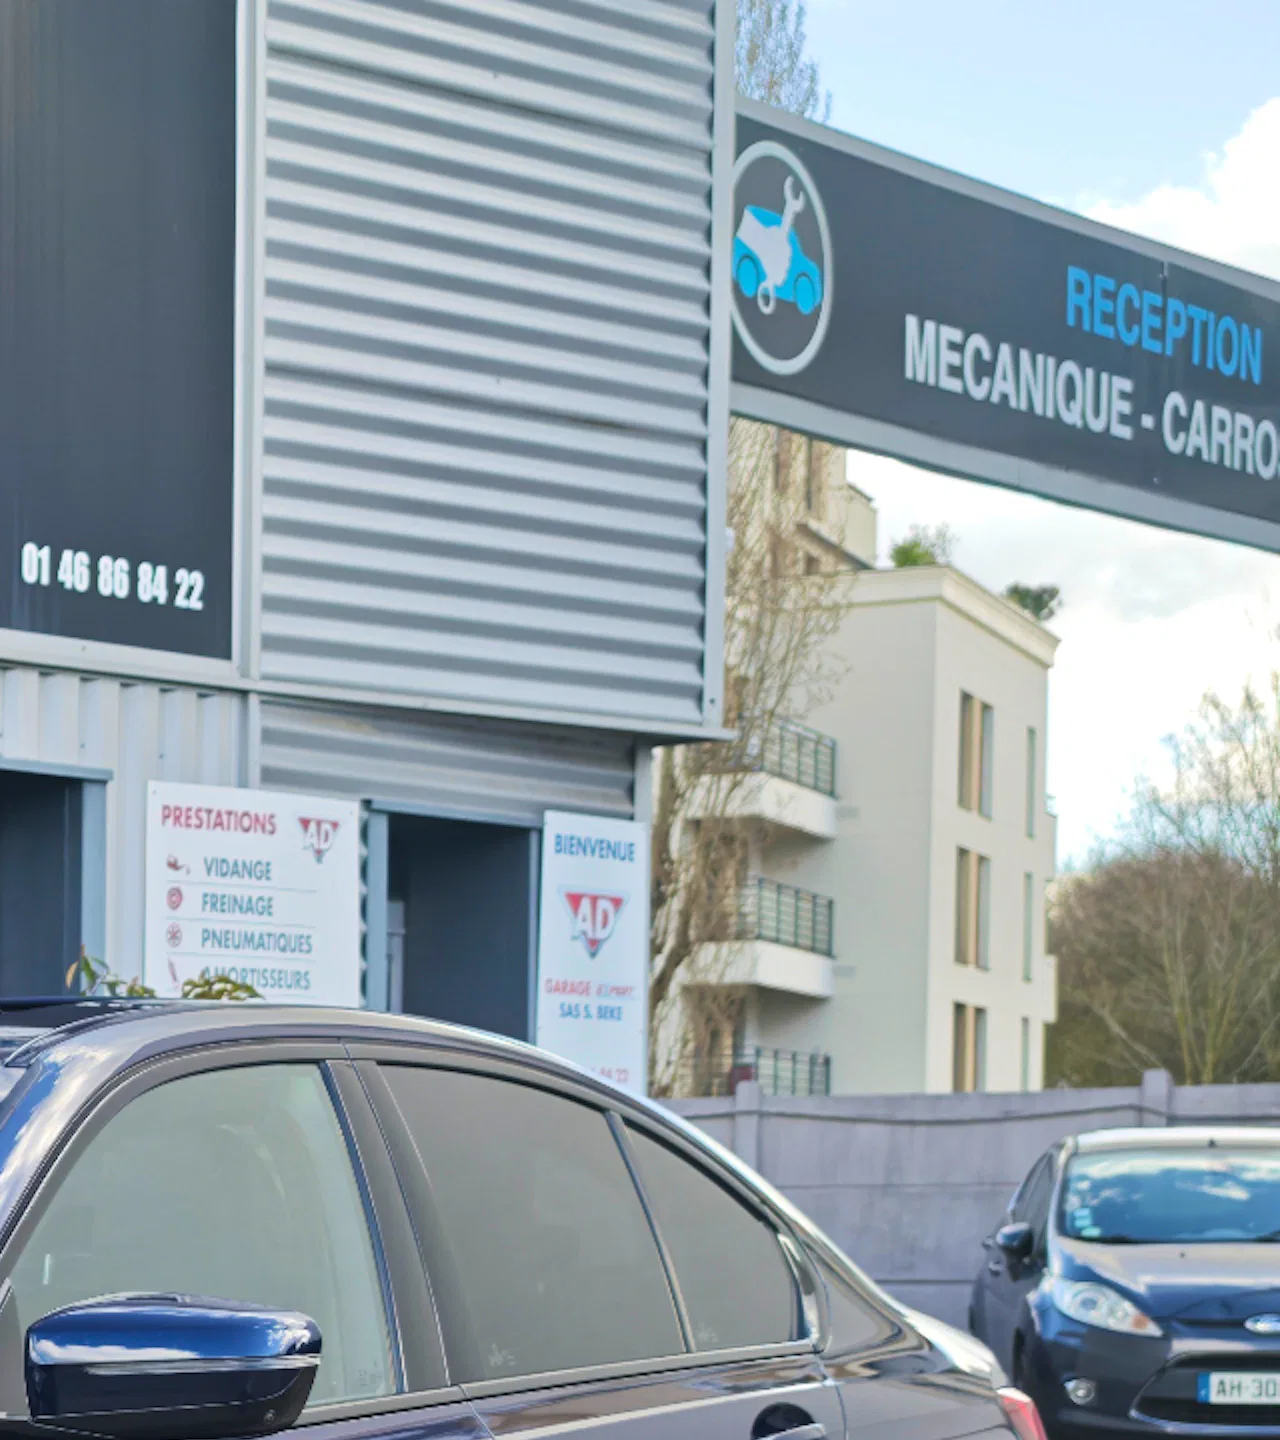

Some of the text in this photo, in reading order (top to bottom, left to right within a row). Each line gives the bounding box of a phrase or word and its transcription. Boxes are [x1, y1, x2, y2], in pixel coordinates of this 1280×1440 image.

[1066, 264, 1263, 386] RECEPTION
[904, 313, 1134, 441] MECANIQUE
[1162, 391, 1280, 481] CARRO
[21, 541, 204, 611] 01 46 86 84 22
[161, 804, 277, 835] PRESTATIONS
[554, 833, 636, 862] BIENVENUE
[203, 856, 273, 881] VIDANGE
[201, 891, 274, 917] FREINAGE
[572, 896, 615, 941] AD
[201, 927, 313, 955] PNEUMATIQUES
[545, 978, 591, 997] GARAGE
[559, 1001, 580, 1019] SAS
